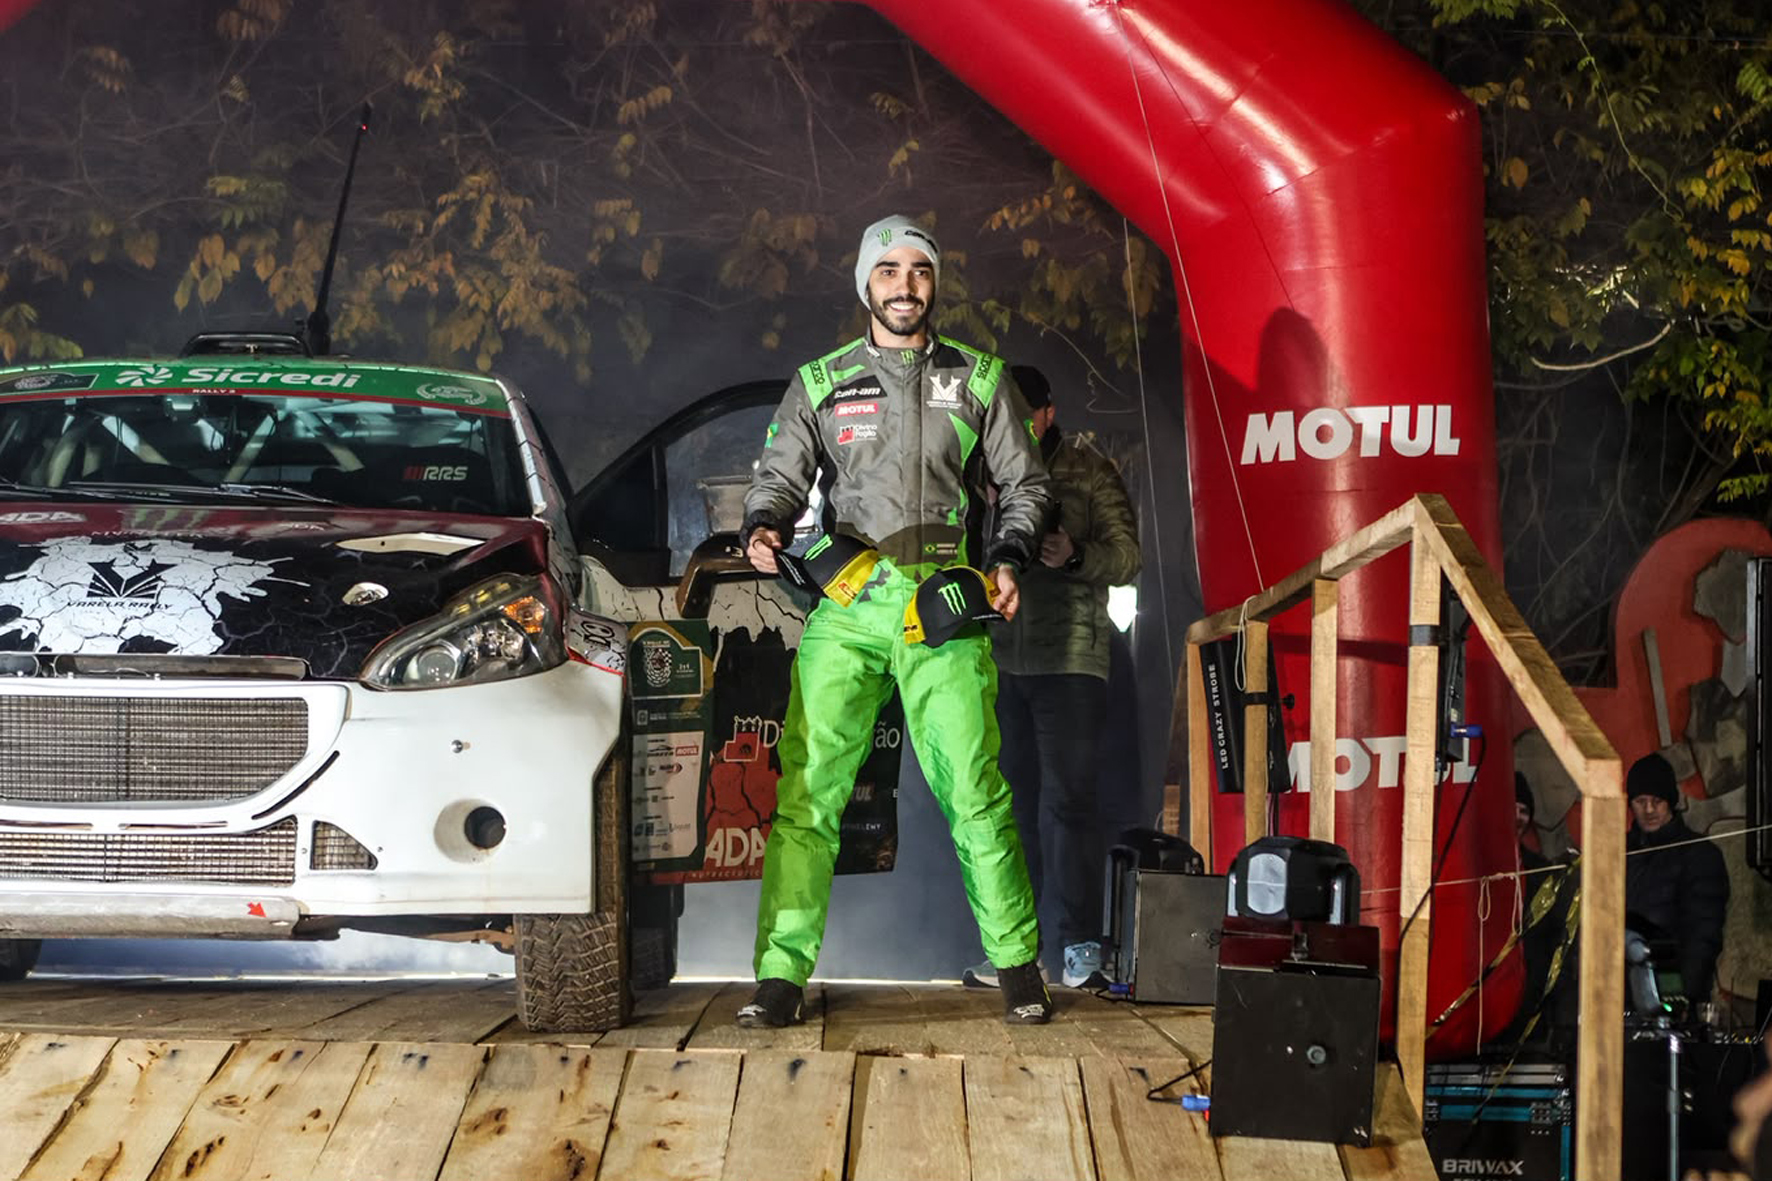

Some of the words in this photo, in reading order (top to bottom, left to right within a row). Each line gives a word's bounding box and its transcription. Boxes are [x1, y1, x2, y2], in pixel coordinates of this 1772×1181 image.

[181, 367, 362, 388] Sicredi
[837, 404, 876, 416] MOTUL
[1240, 404, 1461, 466] MOTUL
[422, 465, 469, 481] RRS
[128, 601, 174, 610] RALLY
[1207, 663, 1221, 707] STROBE
[1214, 711, 1226, 747] CRAZY
[1219, 749, 1229, 769] LED
[1442, 1158, 1524, 1176] BRIWAX
